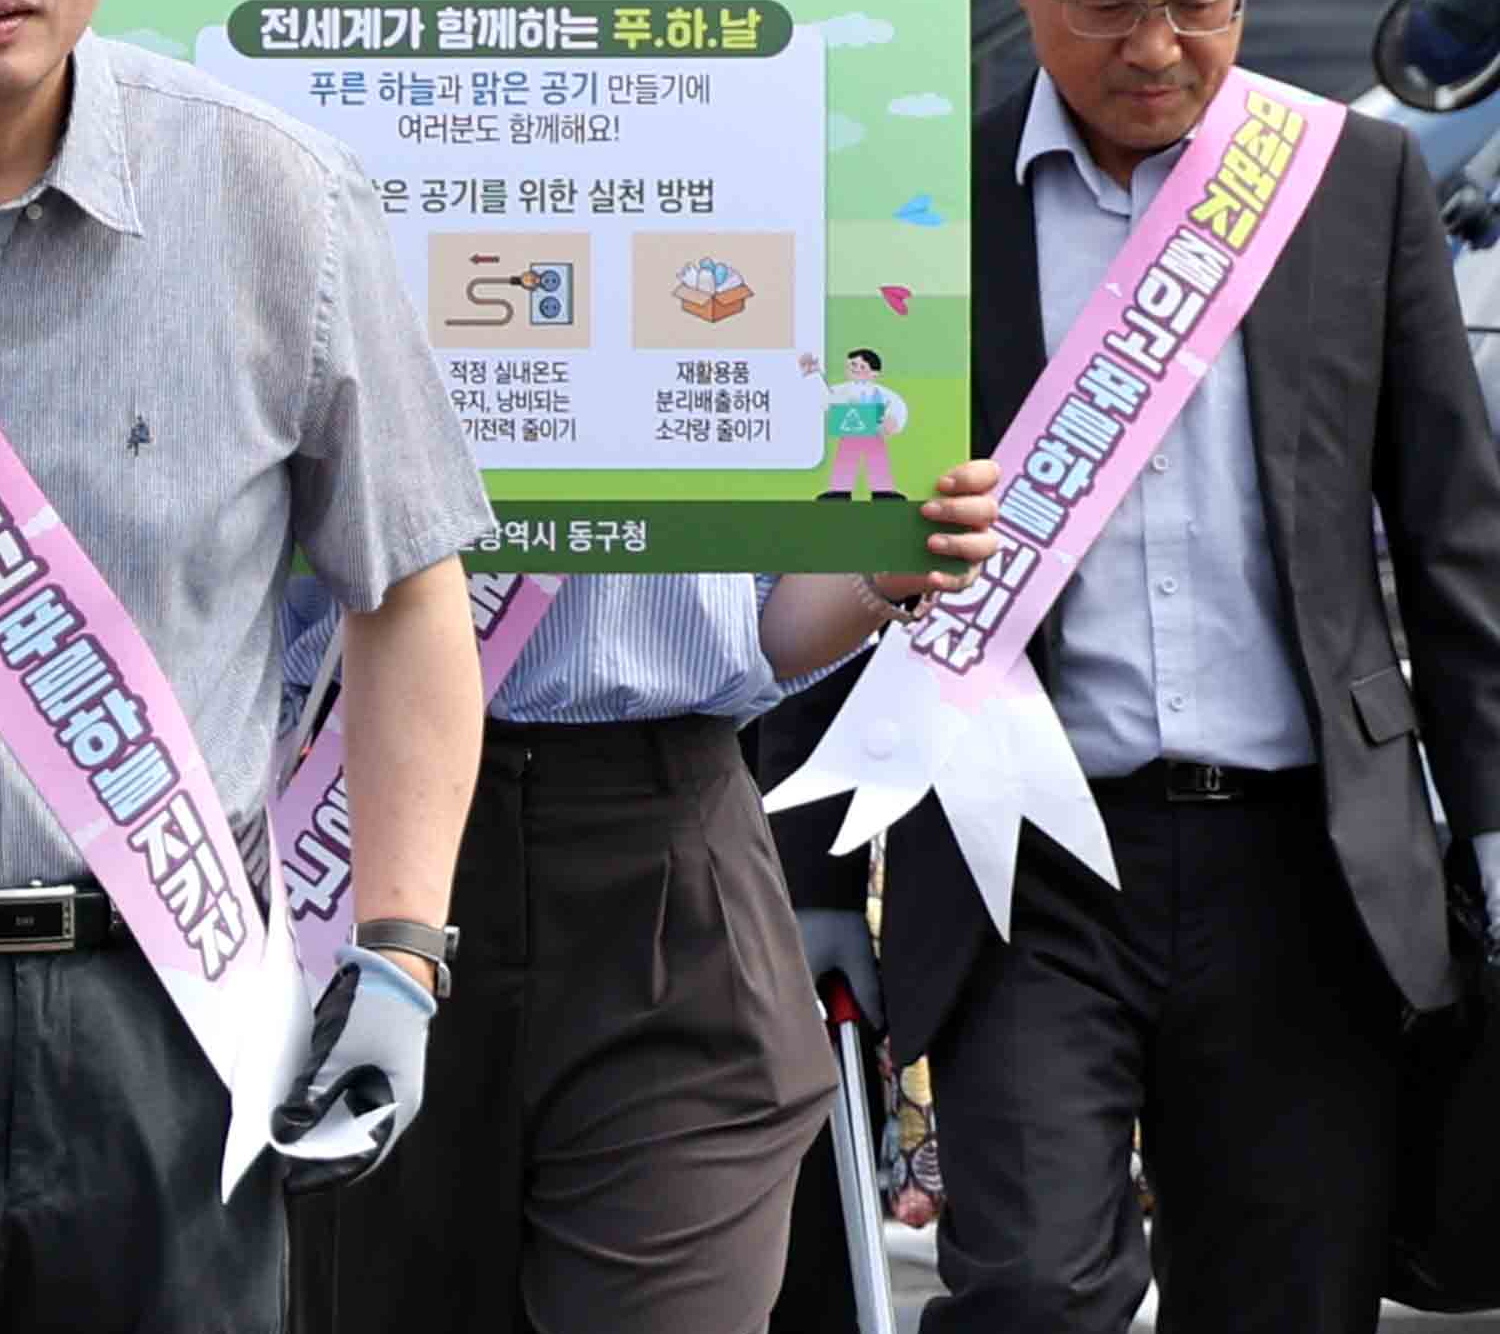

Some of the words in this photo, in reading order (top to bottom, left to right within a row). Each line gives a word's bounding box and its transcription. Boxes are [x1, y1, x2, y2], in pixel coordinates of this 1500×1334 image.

[260, 7, 425, 51] 전세계가
[435, 7, 600, 51] 함께하는
[613, 7, 762, 51] 푸.하.날
[309, 73, 368, 107] 푸른
[379, 72, 464, 107] 하늘과
[471, 72, 530, 107] 맑은
[540, 72, 598, 107] 공기
[607, 72, 712, 107] 만들기에
[398, 112, 499, 145] 여러분도
[508, 112, 621, 145] 함께해요!
[1188, 89, 1309, 255] 미세먼지
[371, 178, 410, 215] 은
[420, 178, 509, 215] 공기를
[518, 178, 579, 215] 위한
[588, 178, 646, 215] 실천
[656, 178, 715, 215] 방법
[1114, 223, 1235, 379] 줄이고
[449, 360, 487, 385] 적정
[494, 360, 570, 385] 실내온도
[675, 360, 751, 385] 재활용품
[496, 389, 570, 414] 낭비되는
[655, 389, 771, 414] 분리배출하여
[461, 418, 516, 443] 기전력
[522, 418, 577, 443] 줄이기
[655, 418, 711, 443] 소각량
[716, 418, 772, 443] 줄이기
[994, 327, 1149, 543] 푸른하늘
[567, 520, 647, 552] 동구청
[127, 789, 249, 982] 지키자
